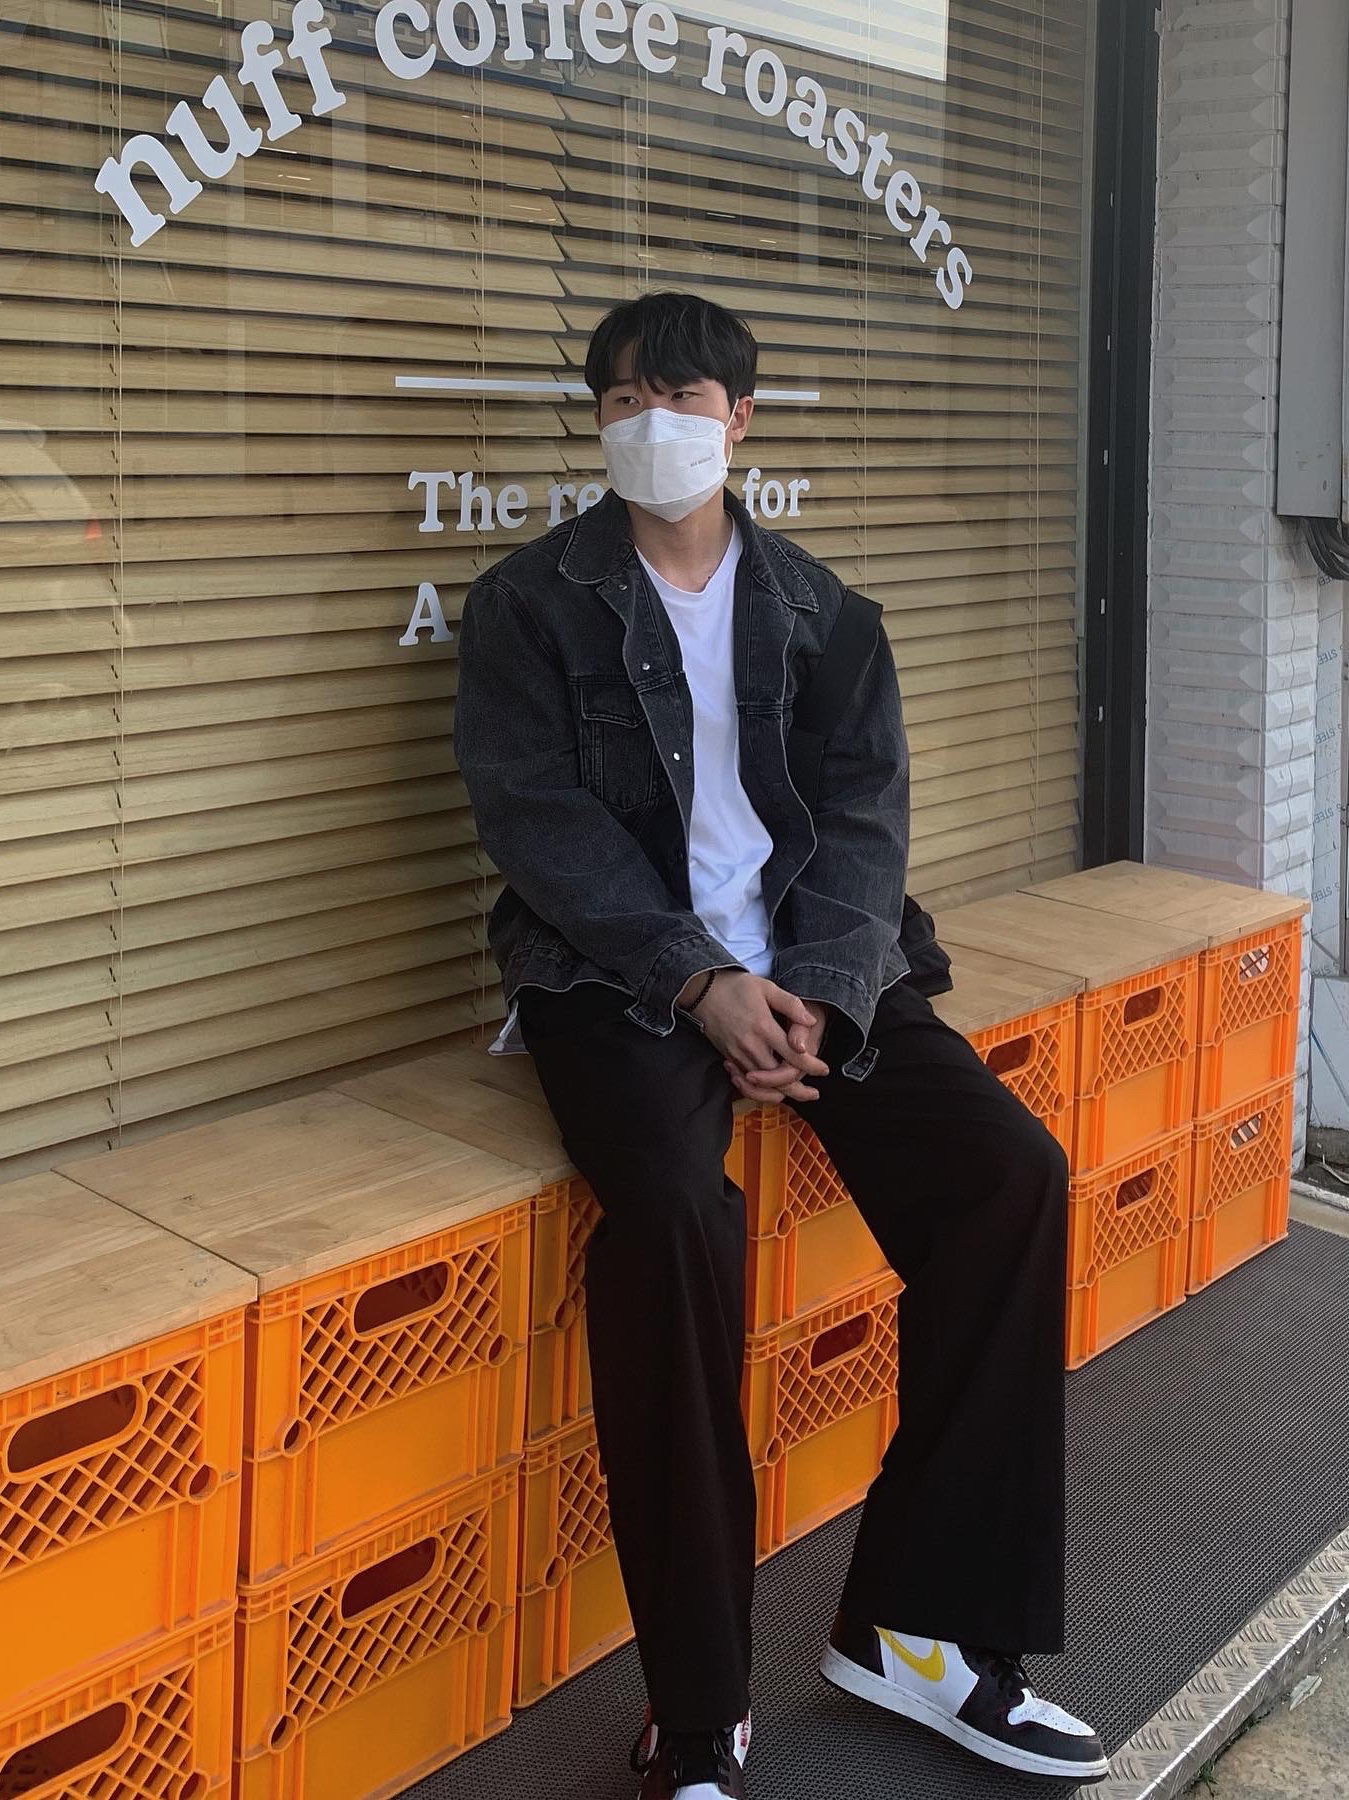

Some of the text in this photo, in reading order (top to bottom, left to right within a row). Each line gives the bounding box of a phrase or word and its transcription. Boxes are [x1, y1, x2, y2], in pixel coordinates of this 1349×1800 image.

[95, 0, 347, 248] nuff
[700, 26, 973, 310] roasters
[408, 470, 529, 533] The
[741, 467, 811, 519] for
[399, 582, 455, 647] A
